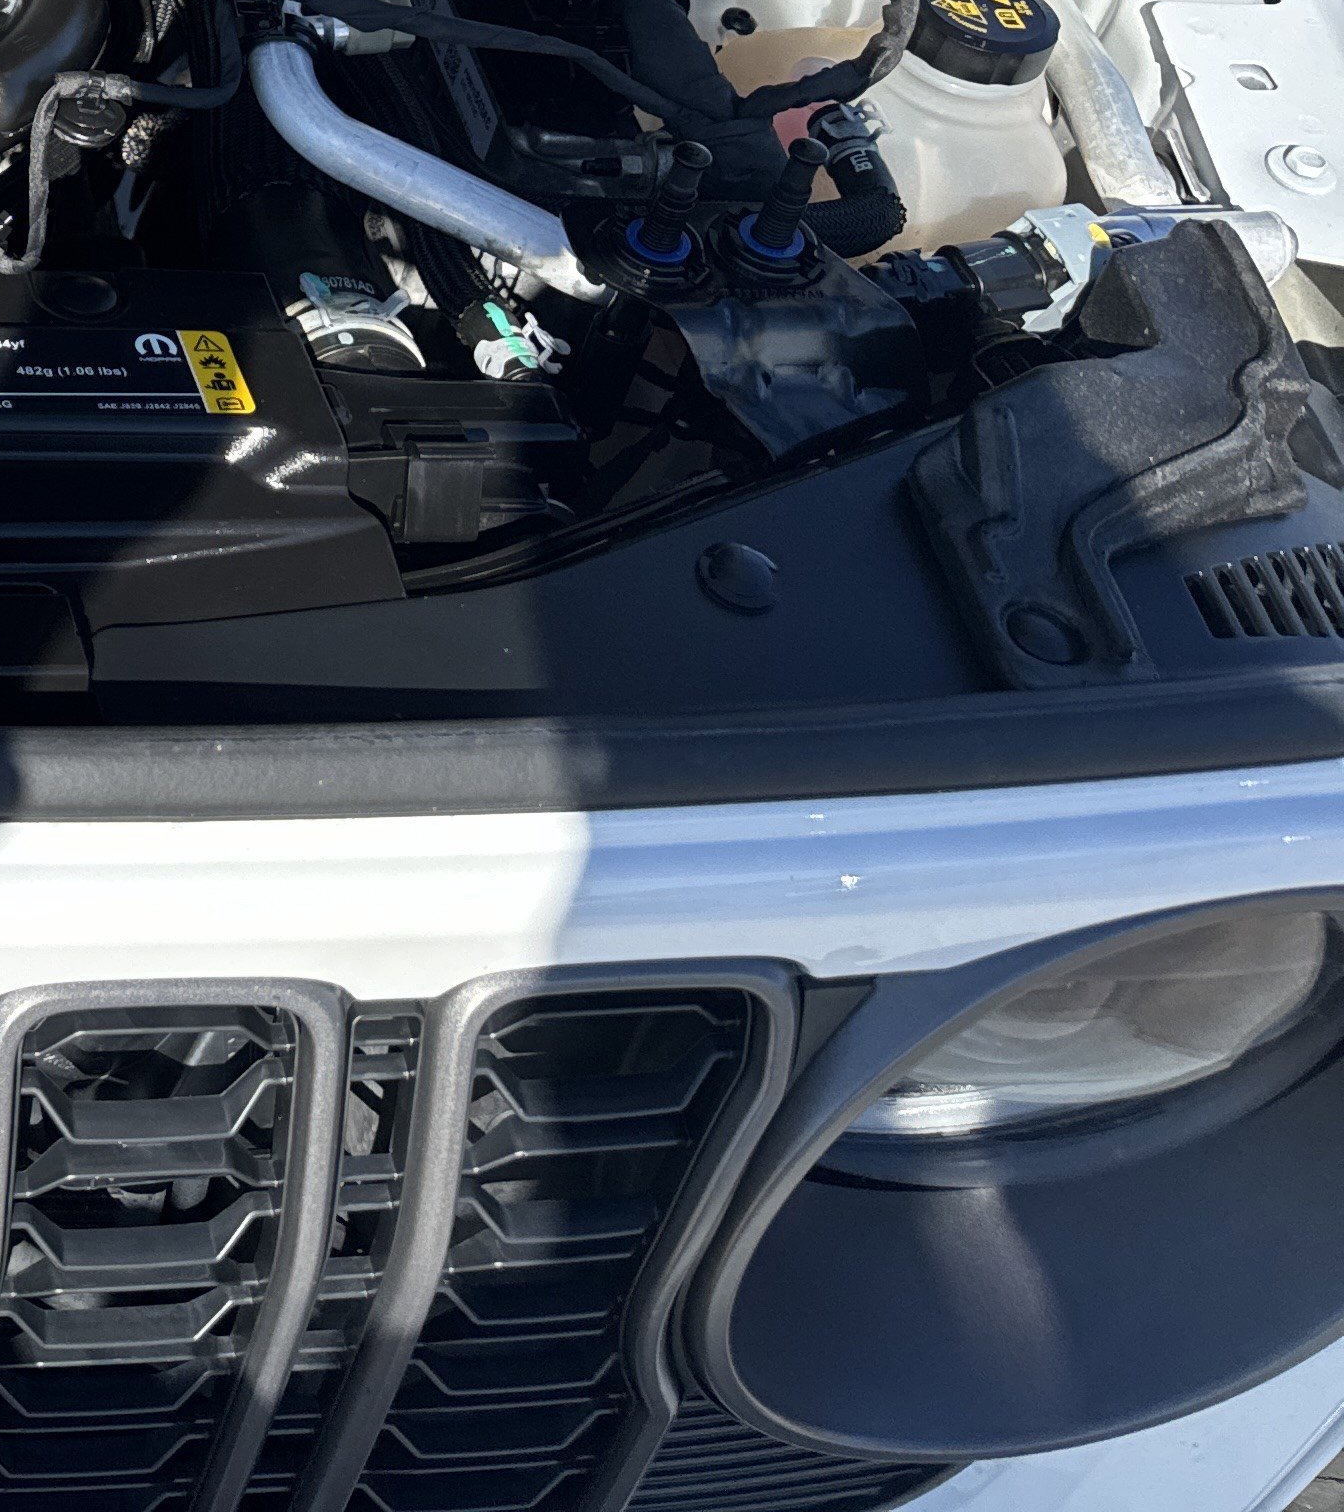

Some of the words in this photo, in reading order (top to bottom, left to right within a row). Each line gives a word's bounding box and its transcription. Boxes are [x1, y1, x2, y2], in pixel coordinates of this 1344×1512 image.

[16, 366, 53, 378] 482g
[57, 366, 95, 378] (1.06
[97, 366, 128, 378] lbs)
